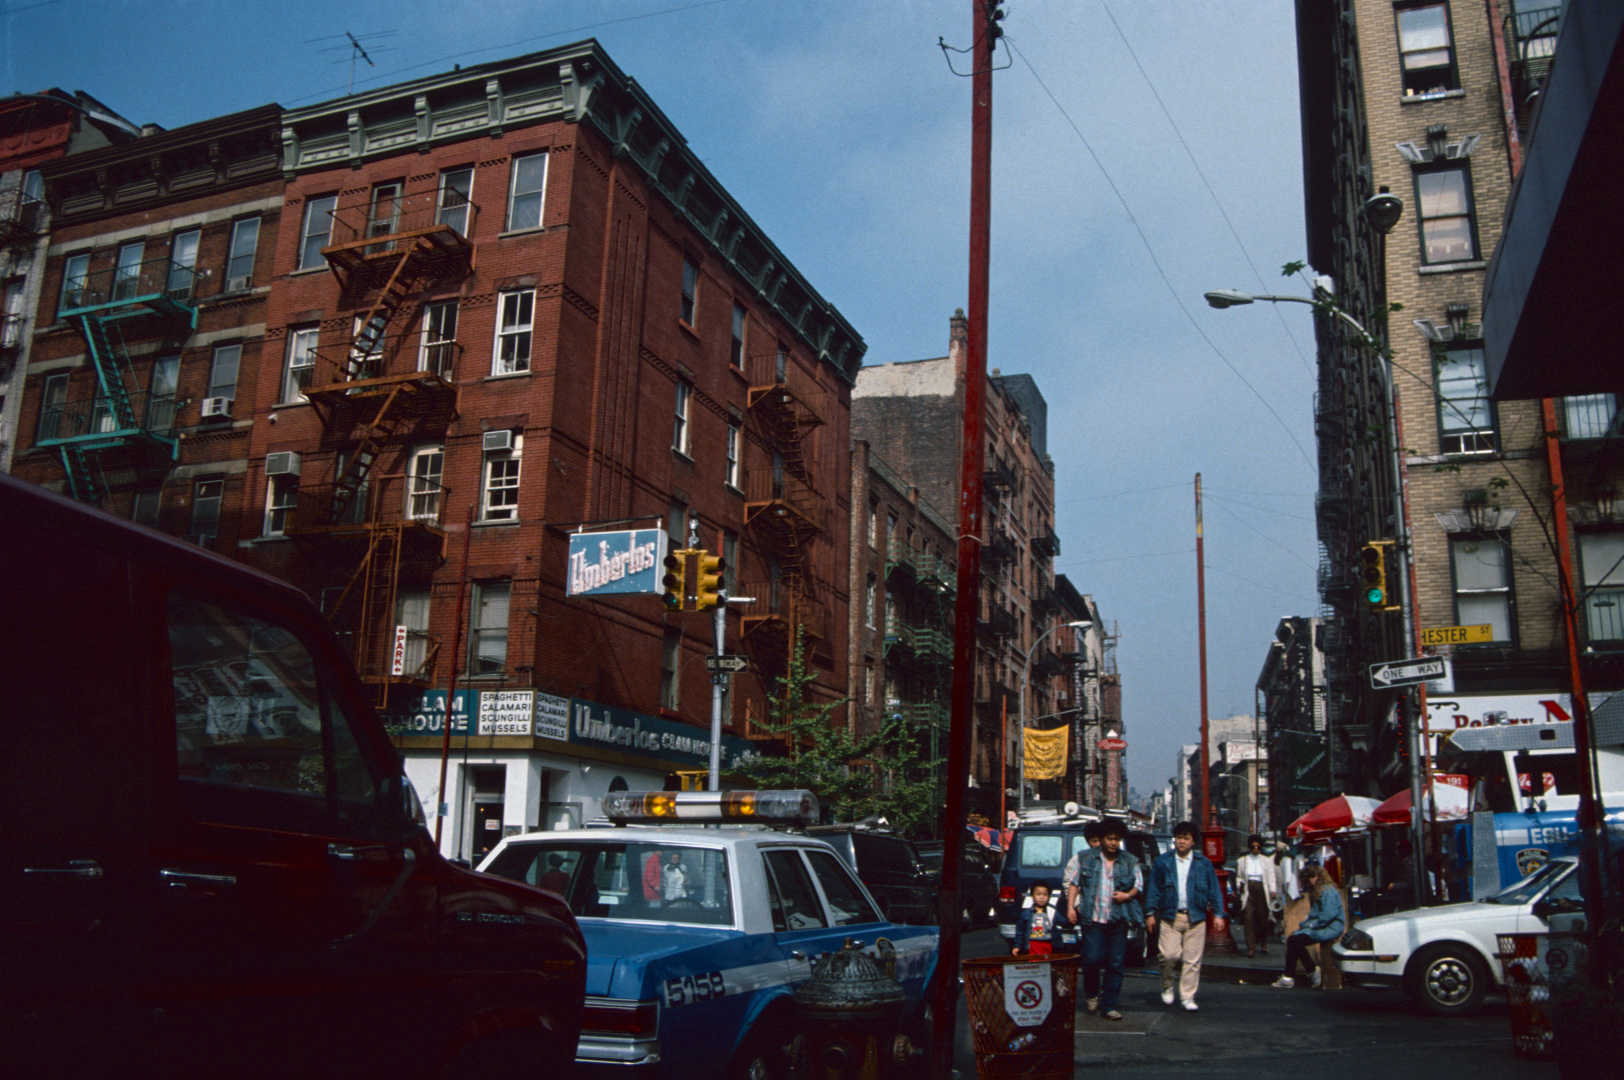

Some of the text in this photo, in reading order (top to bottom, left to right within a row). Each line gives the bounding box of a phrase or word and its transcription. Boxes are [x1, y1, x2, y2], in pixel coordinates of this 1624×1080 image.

[1420, 626, 1490, 643] HESTER ST
[394, 635, 405, 666] PARK
[1382, 662, 1440, 680] ONE WAY
[482, 693, 532, 702] SPAGHETTI
[536, 694, 568, 707] SPAGHETTI
[482, 703, 531, 712] CALAMARI
[536, 705, 568, 717] CALAMARI
[481, 713, 531, 722] SCUNGILLI
[536, 715, 567, 727] SCUNGILLI
[482, 724, 527, 733] MUSSELS
[537, 726, 566, 738] MUSSELS
[575, 703, 660, 751] Umbertos
[661, 732, 692, 753] CLAM
[1446, 777, 1462, 786] 191
[1530, 826, 1569, 844] ESU
[476, 912, 525, 924] ECONOLINE
[666, 971, 726, 1007] 5158
